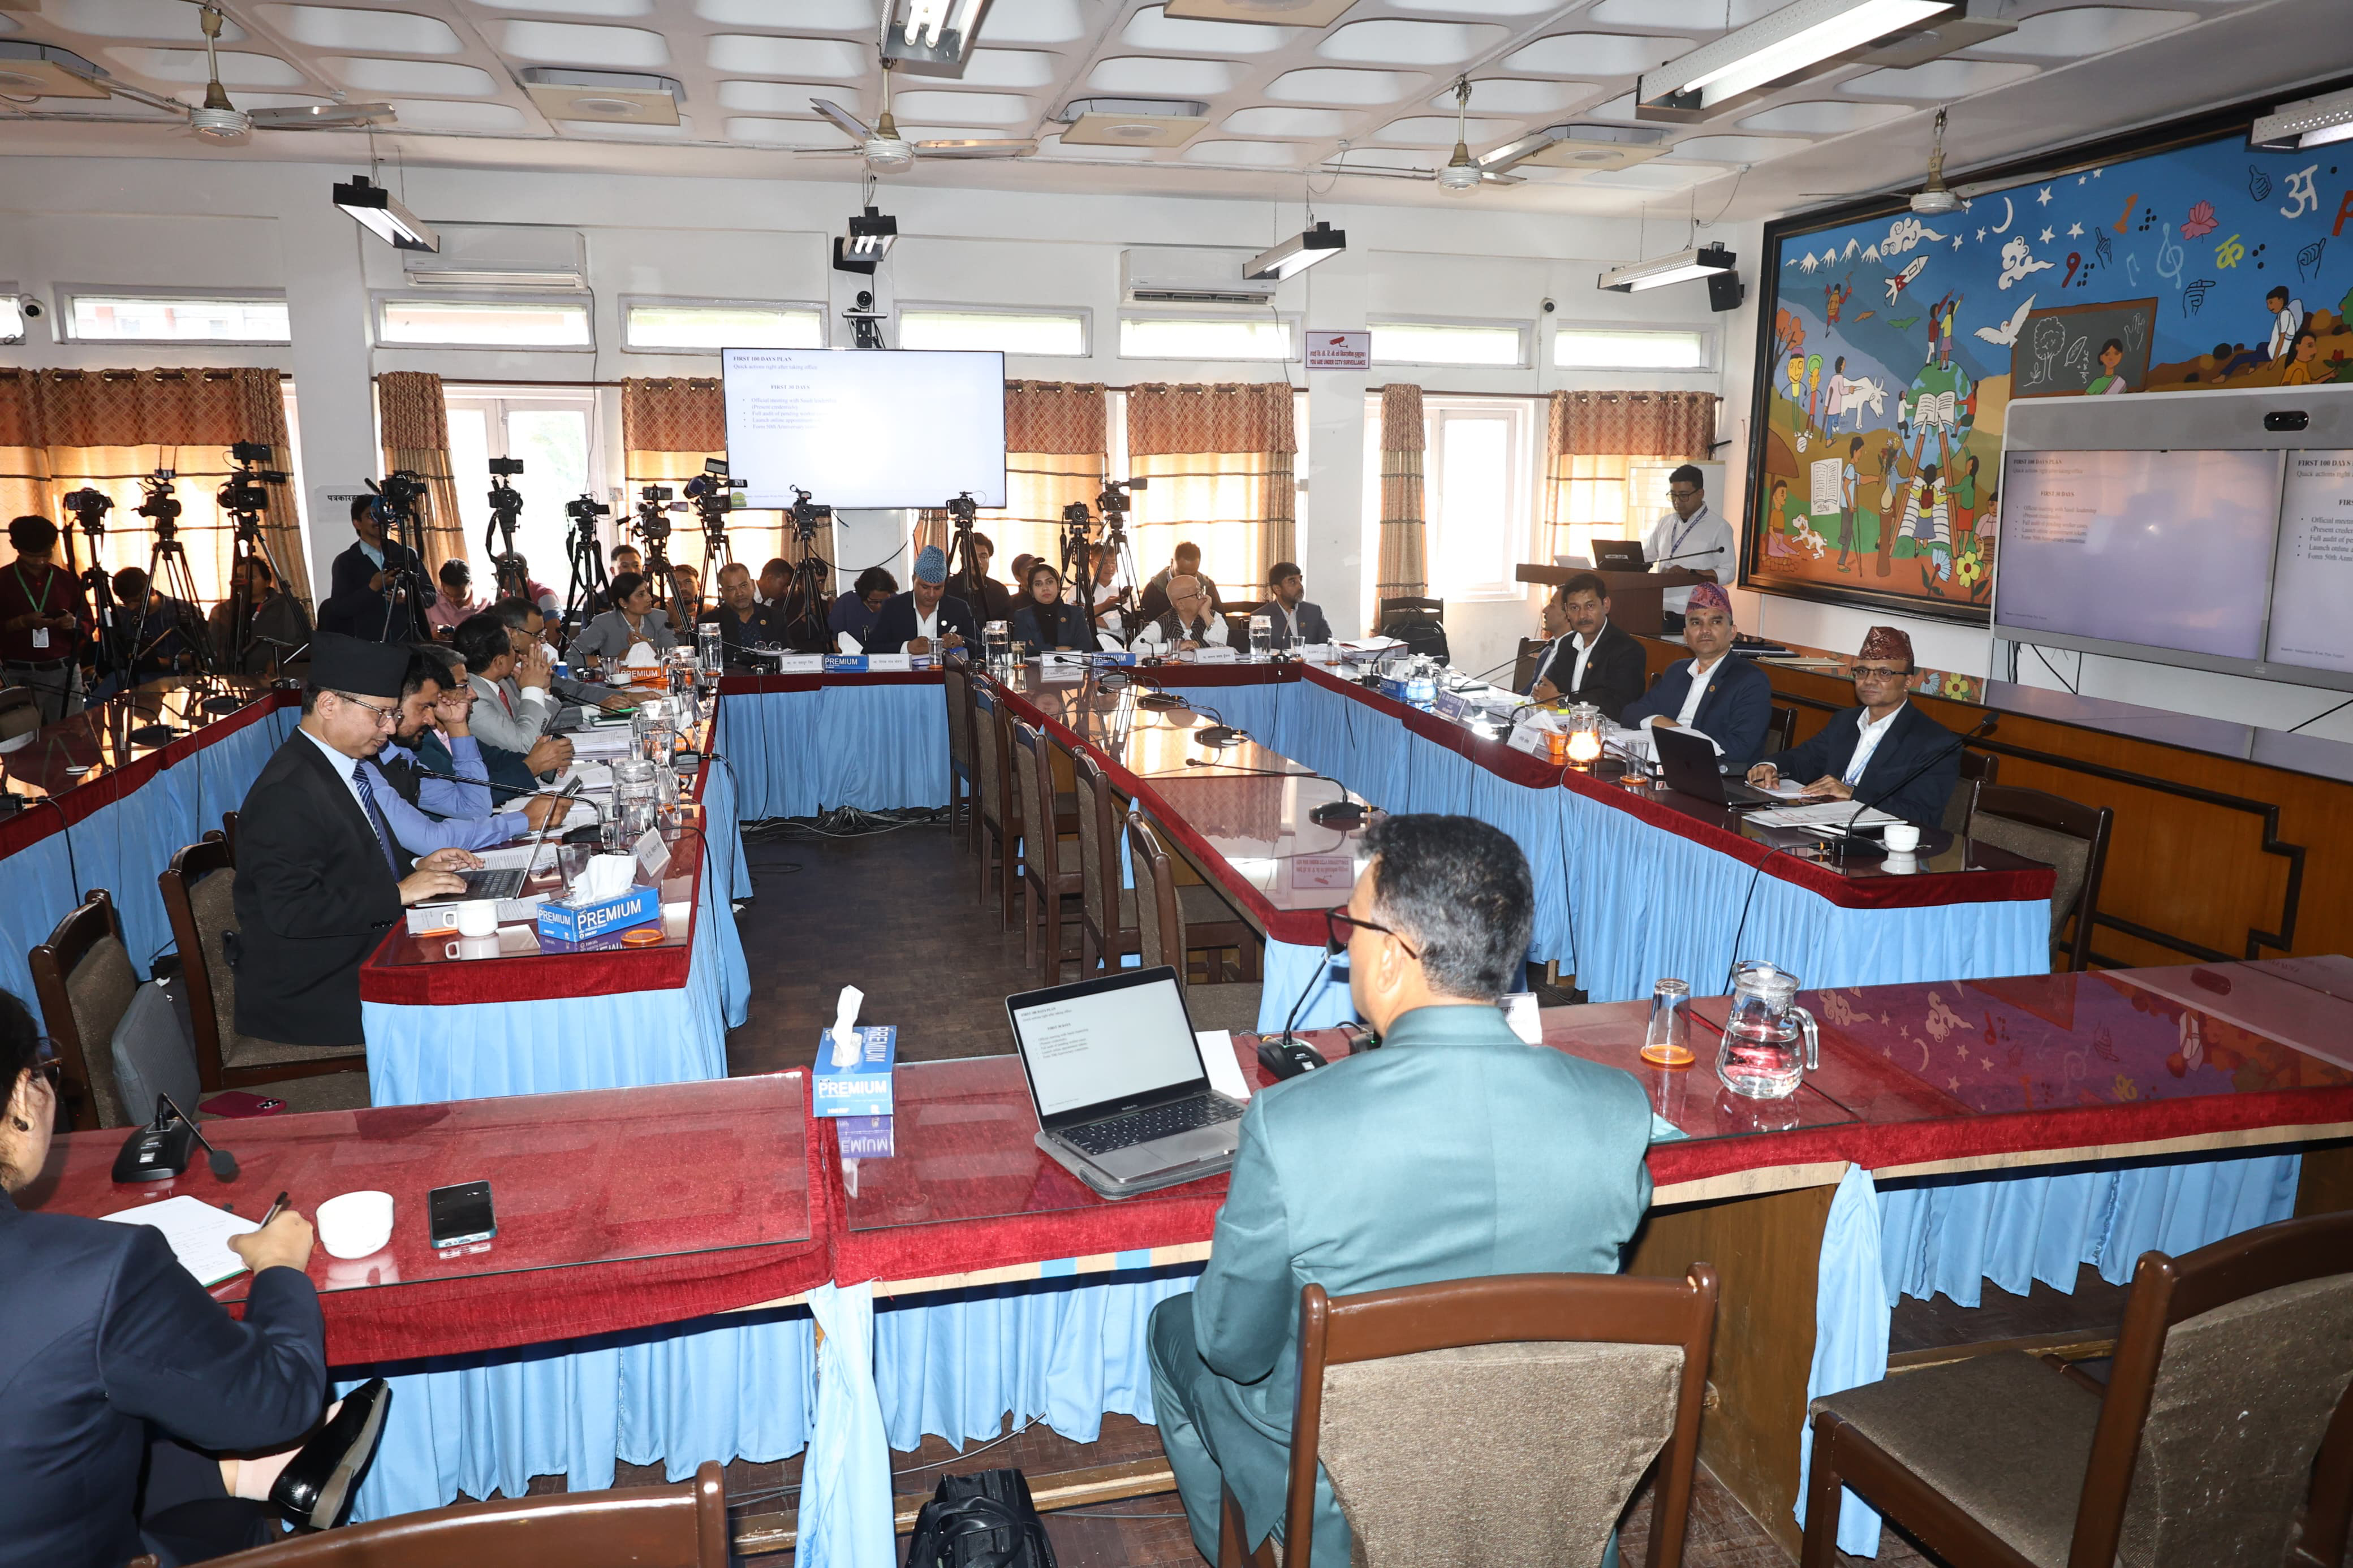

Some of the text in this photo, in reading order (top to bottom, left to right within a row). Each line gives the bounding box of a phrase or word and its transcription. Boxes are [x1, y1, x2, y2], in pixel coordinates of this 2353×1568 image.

[2280, 164, 2318, 219] अ
[2214, 234, 2245, 270] क
[538, 909, 571, 926] PREMIUM
[578, 899, 641, 931] PREMIUM
[865, 1026, 889, 1062] PREMIUM
[818, 1080, 887, 1096] PREMIUM
